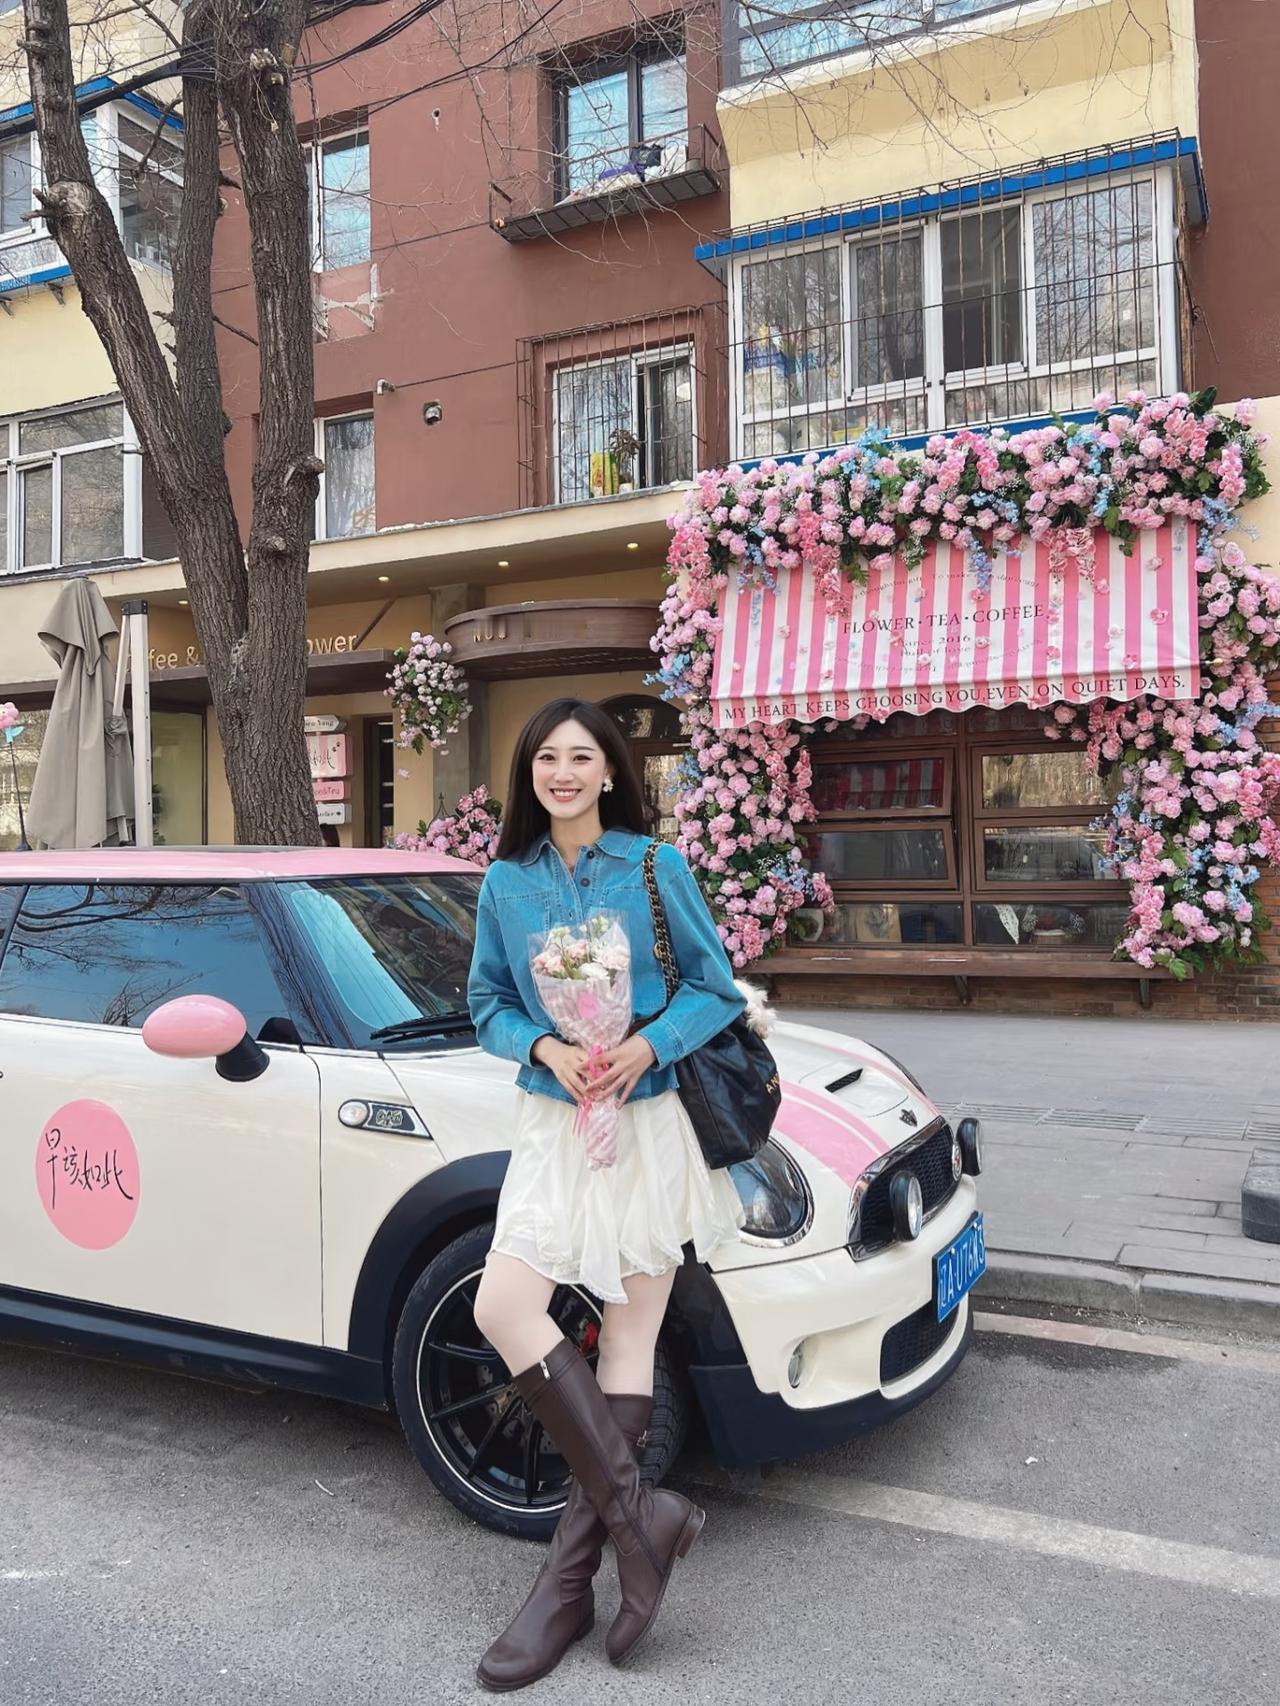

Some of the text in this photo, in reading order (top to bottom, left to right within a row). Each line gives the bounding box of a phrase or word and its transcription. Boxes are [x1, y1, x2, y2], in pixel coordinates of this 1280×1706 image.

[938, 635, 971, 645] 2016
[725, 707, 746, 720] MY
[752, 703, 799, 718] HEART
[806, 699, 850, 714] KEEPS
[855, 691, 944, 711] CHOOSING
[1036, 682, 1064, 697] ON
[1071, 678, 1127, 697] QUIET
[1135, 675, 1186, 691] DAYS.
[45, 1128, 134, 1210] 早该如此
